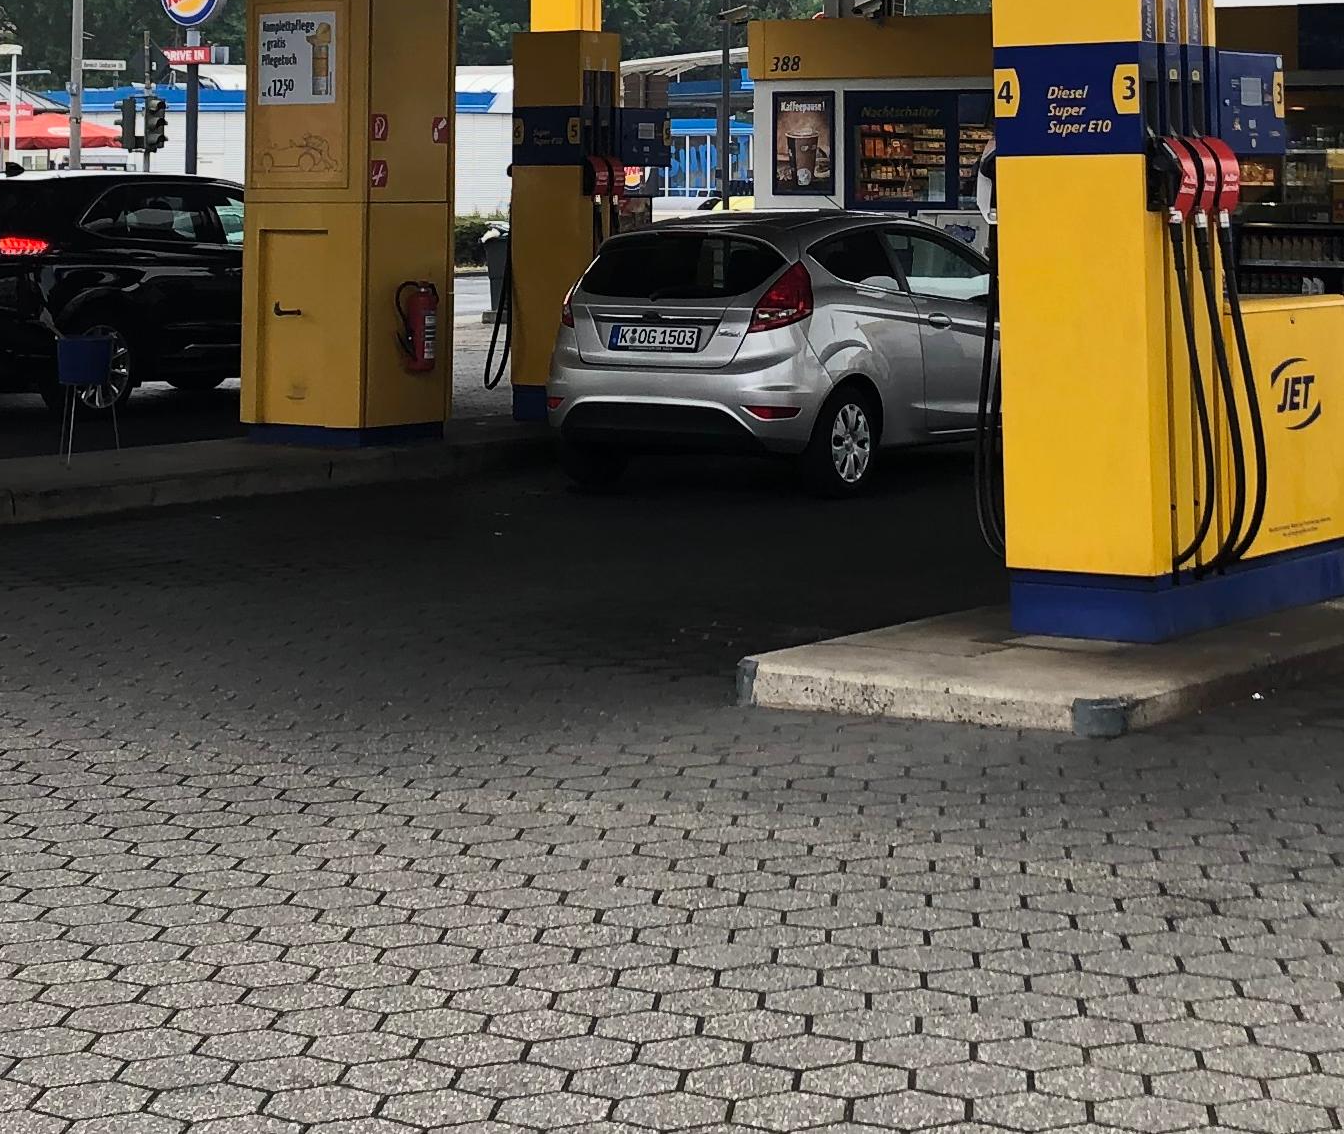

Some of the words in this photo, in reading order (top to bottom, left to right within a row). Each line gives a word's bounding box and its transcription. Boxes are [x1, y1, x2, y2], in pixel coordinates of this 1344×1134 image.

[194, 50, 205, 61] IN
[770, 56, 802, 73] 388
[997, 81, 1013, 104] 4
[1047, 85, 1089, 99] Diesel
[1122, 76, 1136, 100] 3
[1277, 82, 1283, 104] 3
[1048, 104, 1086, 120] Super
[571, 124, 578, 138] 5
[1048, 121, 1086, 137] Super
[1087, 119, 1112, 133] E10
[619, 329, 630, 344] K
[638, 329, 658, 345] OG
[659, 330, 696, 346] 1503
[1277, 375, 1315, 414] JET
